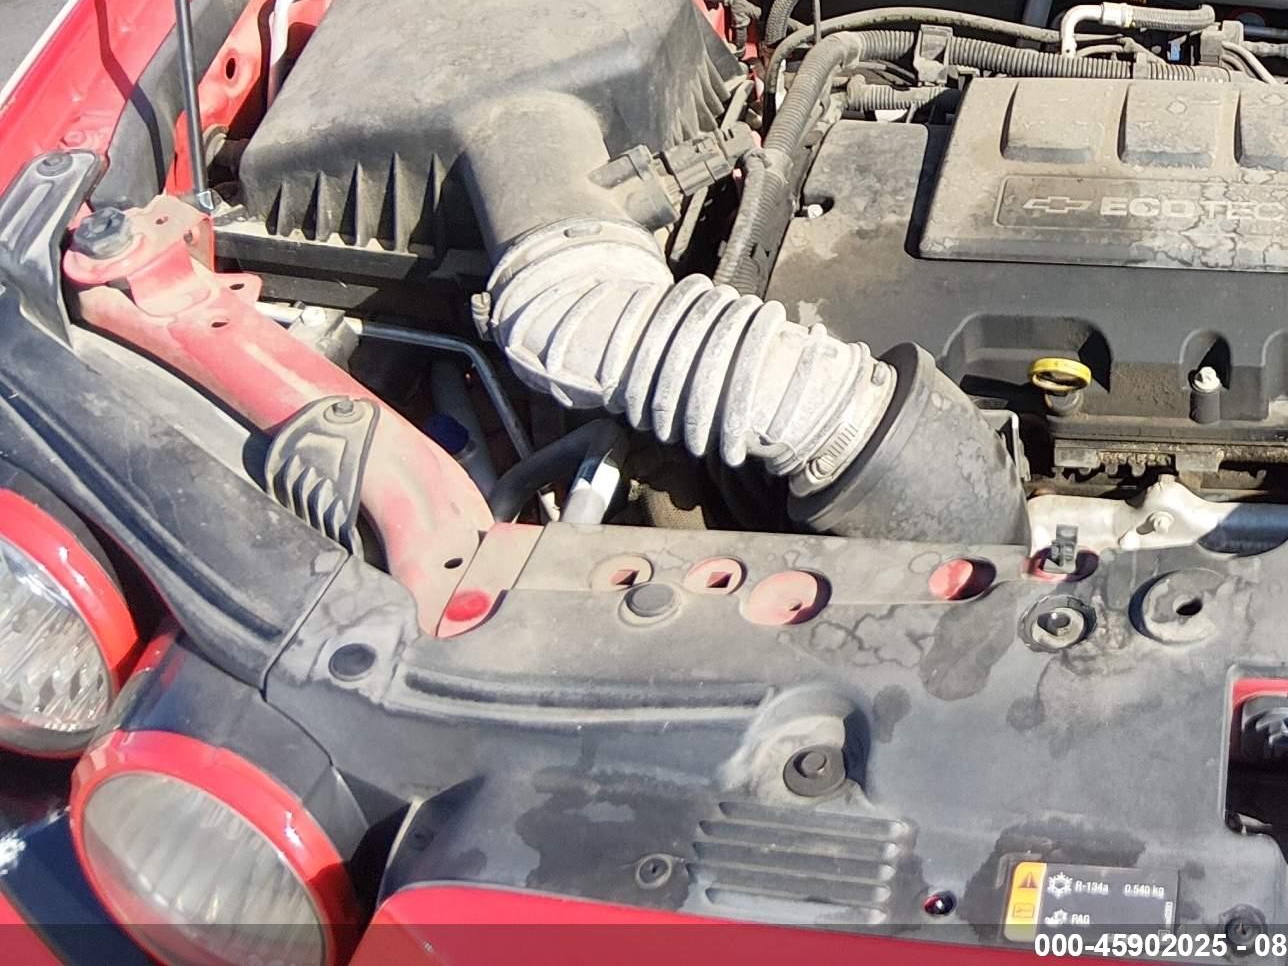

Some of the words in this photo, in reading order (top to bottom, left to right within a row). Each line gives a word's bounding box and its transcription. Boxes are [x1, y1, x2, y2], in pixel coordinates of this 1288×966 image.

[1100, 196, 1285, 221] ECOTEC
[1074, 880, 1109, 895] R-134a
[1124, 883, 1151, 898] 0.540
[1152, 885, 1165, 899] kg
[1071, 913, 1090, 926] PAG
